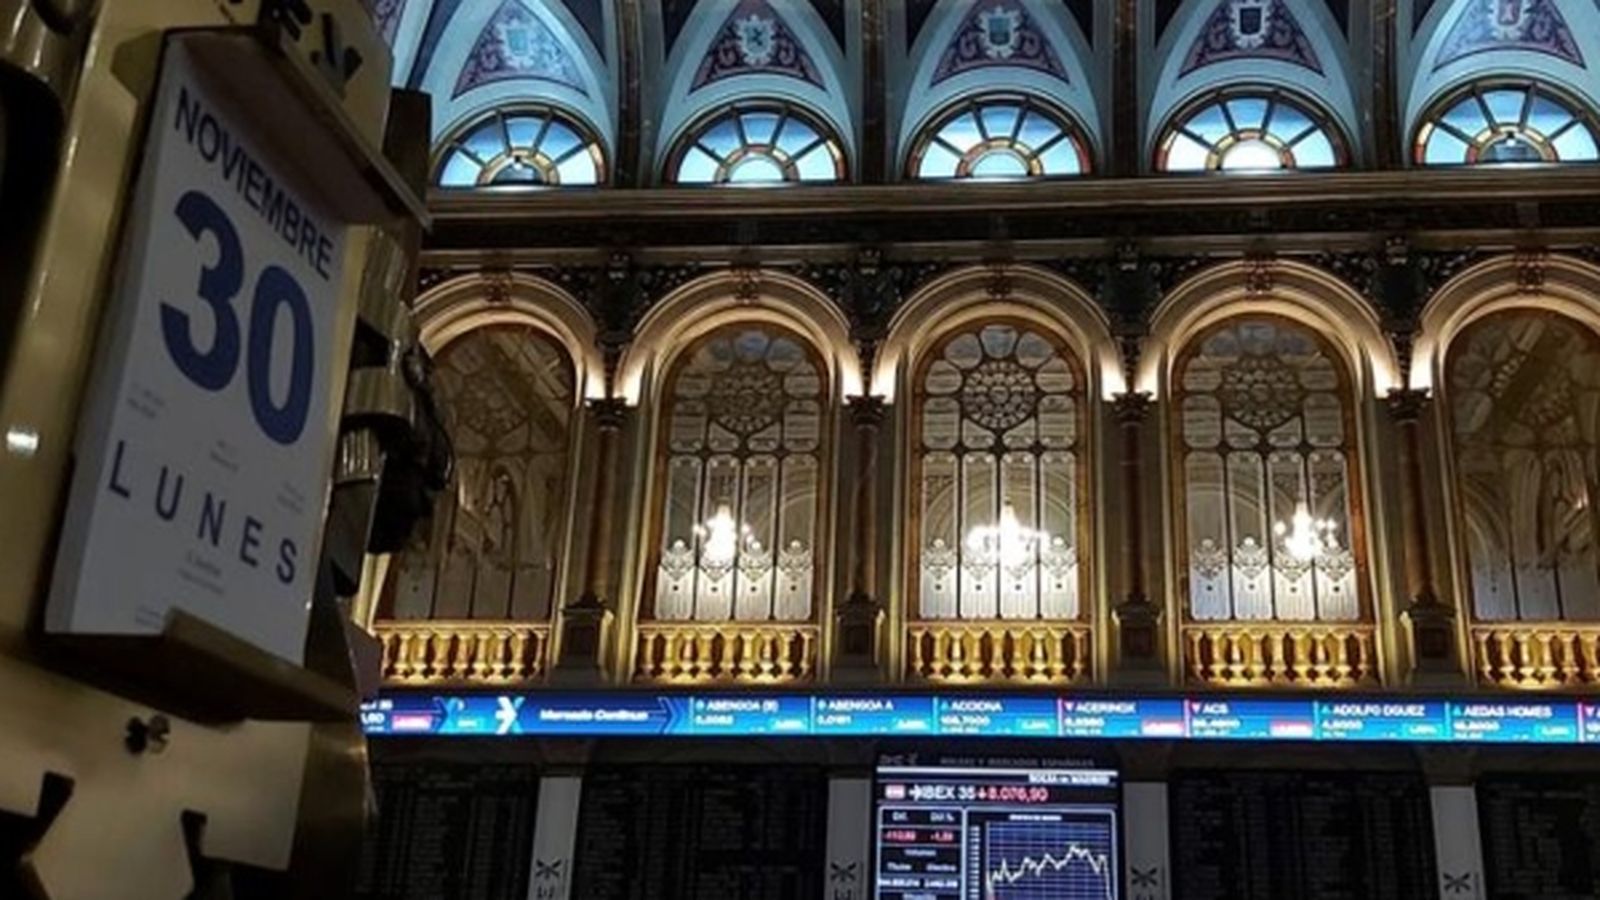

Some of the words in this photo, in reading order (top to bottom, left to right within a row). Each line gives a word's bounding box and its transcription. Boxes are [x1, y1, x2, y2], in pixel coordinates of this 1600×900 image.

[174, 87, 334, 281] NOVIEMBRE
[160, 189, 314, 445] 30
[108, 440, 298, 584] LUNES
[706, 700, 760, 711] ABENGOA
[829, 700, 882, 711] ABENGOA
[884, 701, 893, 711] A
[951, 701, 1003, 712] ACCIONA
[1076, 702, 1136, 713] ACERINOX
[1203, 703, 1229, 715] ACS
[1333, 704, 1381, 716] ADOLFO
[1383, 705, 1425, 717] DGUEZ
[1464, 705, 1505, 717] AEDAS
[1507, 705, 1553, 718] HOMES
[540, 708, 593, 720] Mercado
[594, 708, 648, 721] Continuo
[920, 784, 955, 799] IBEX
[958, 785, 976, 799] 35
[988, 786, 1048, 801] 8.076,90
